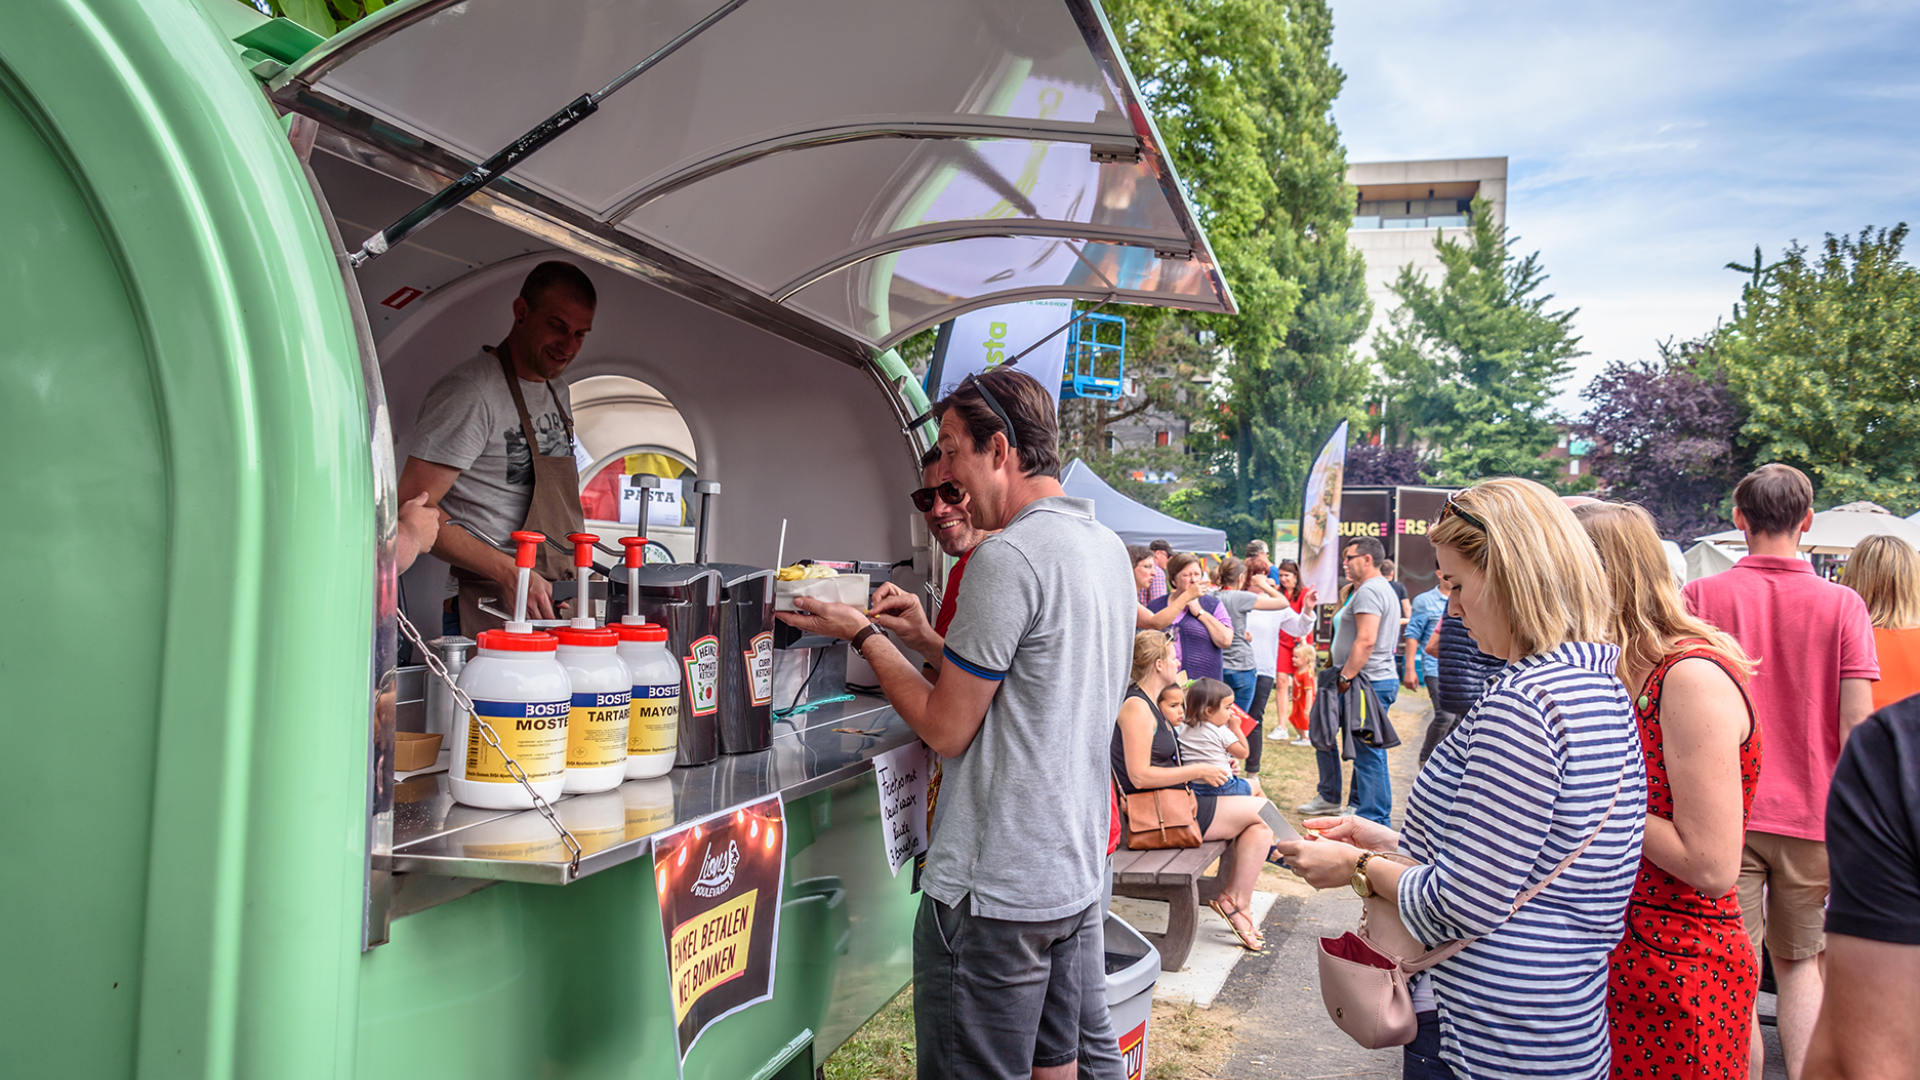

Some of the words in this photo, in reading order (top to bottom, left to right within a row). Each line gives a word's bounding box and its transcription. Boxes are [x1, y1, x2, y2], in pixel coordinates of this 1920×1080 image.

[698, 645, 717, 659] HEINZ
[695, 880, 731, 898] BOULEVARD
[674, 929, 698, 973] ENKEL
[701, 905, 749, 951] BETALEN
[678, 969, 692, 1008] MET
[693, 943, 737, 992] BONNEN
